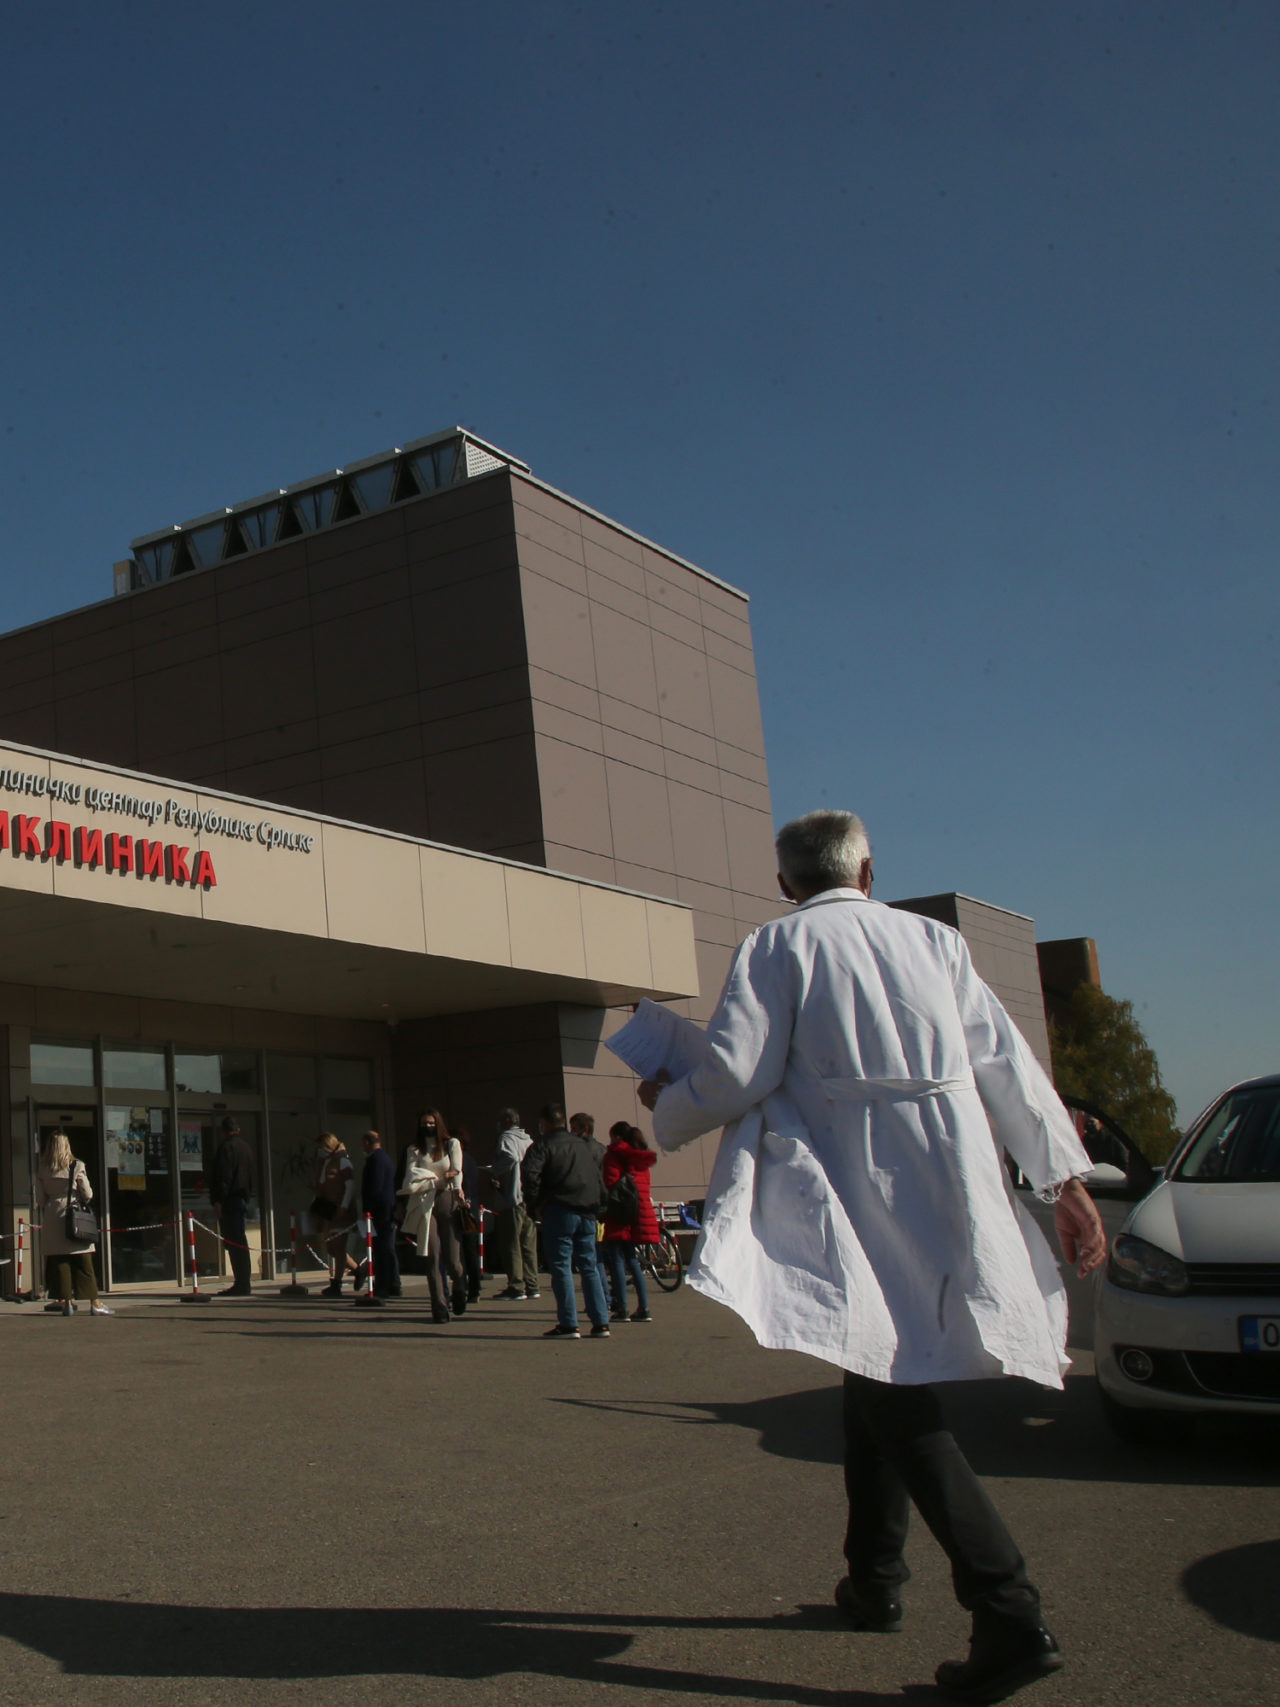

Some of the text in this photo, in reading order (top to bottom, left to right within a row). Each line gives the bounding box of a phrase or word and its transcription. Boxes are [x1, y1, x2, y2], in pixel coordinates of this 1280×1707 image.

[87, 787, 163, 825] центар
[167, 799, 257, 839] Републике
[260, 820, 315, 852] Српске
